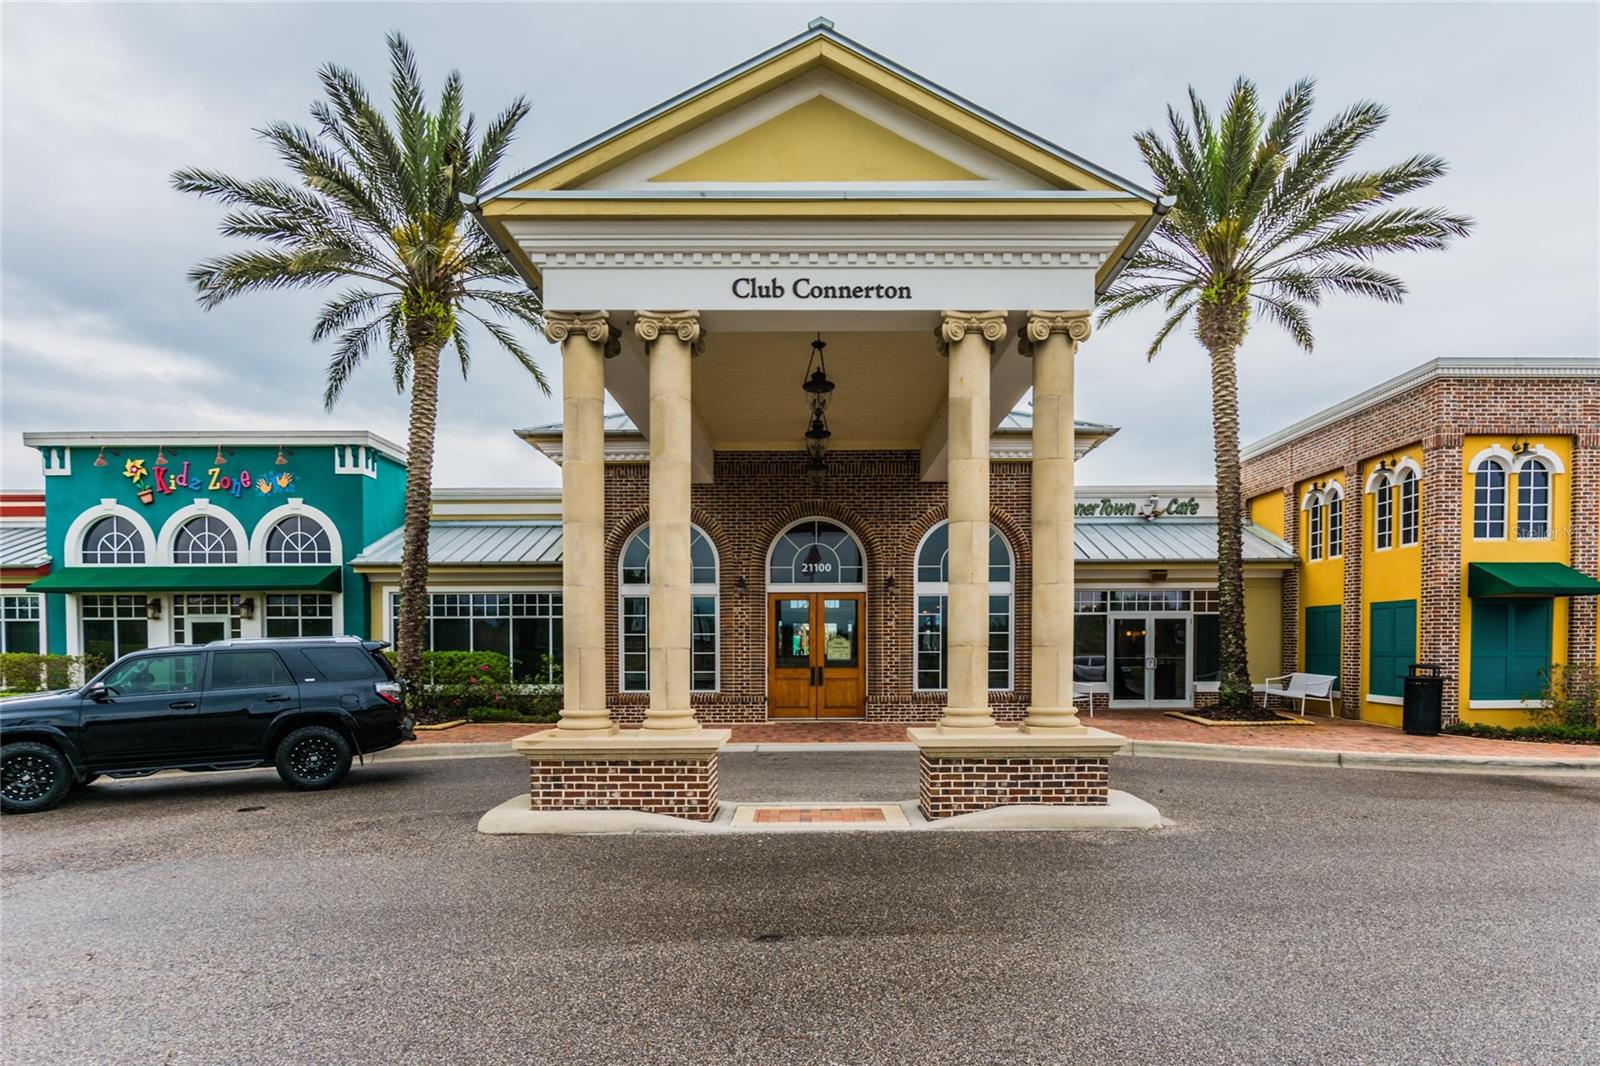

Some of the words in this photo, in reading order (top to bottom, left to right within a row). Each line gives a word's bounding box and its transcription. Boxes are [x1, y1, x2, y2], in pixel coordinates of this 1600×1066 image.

[732, 277, 785, 299] Club
[792, 277, 912, 299] Connerton
[152, 461, 201, 495] Kidz
[208, 467, 251, 498] Zone
[1166, 497, 1200, 515] Cafe
[801, 563, 832, 572] 21100
